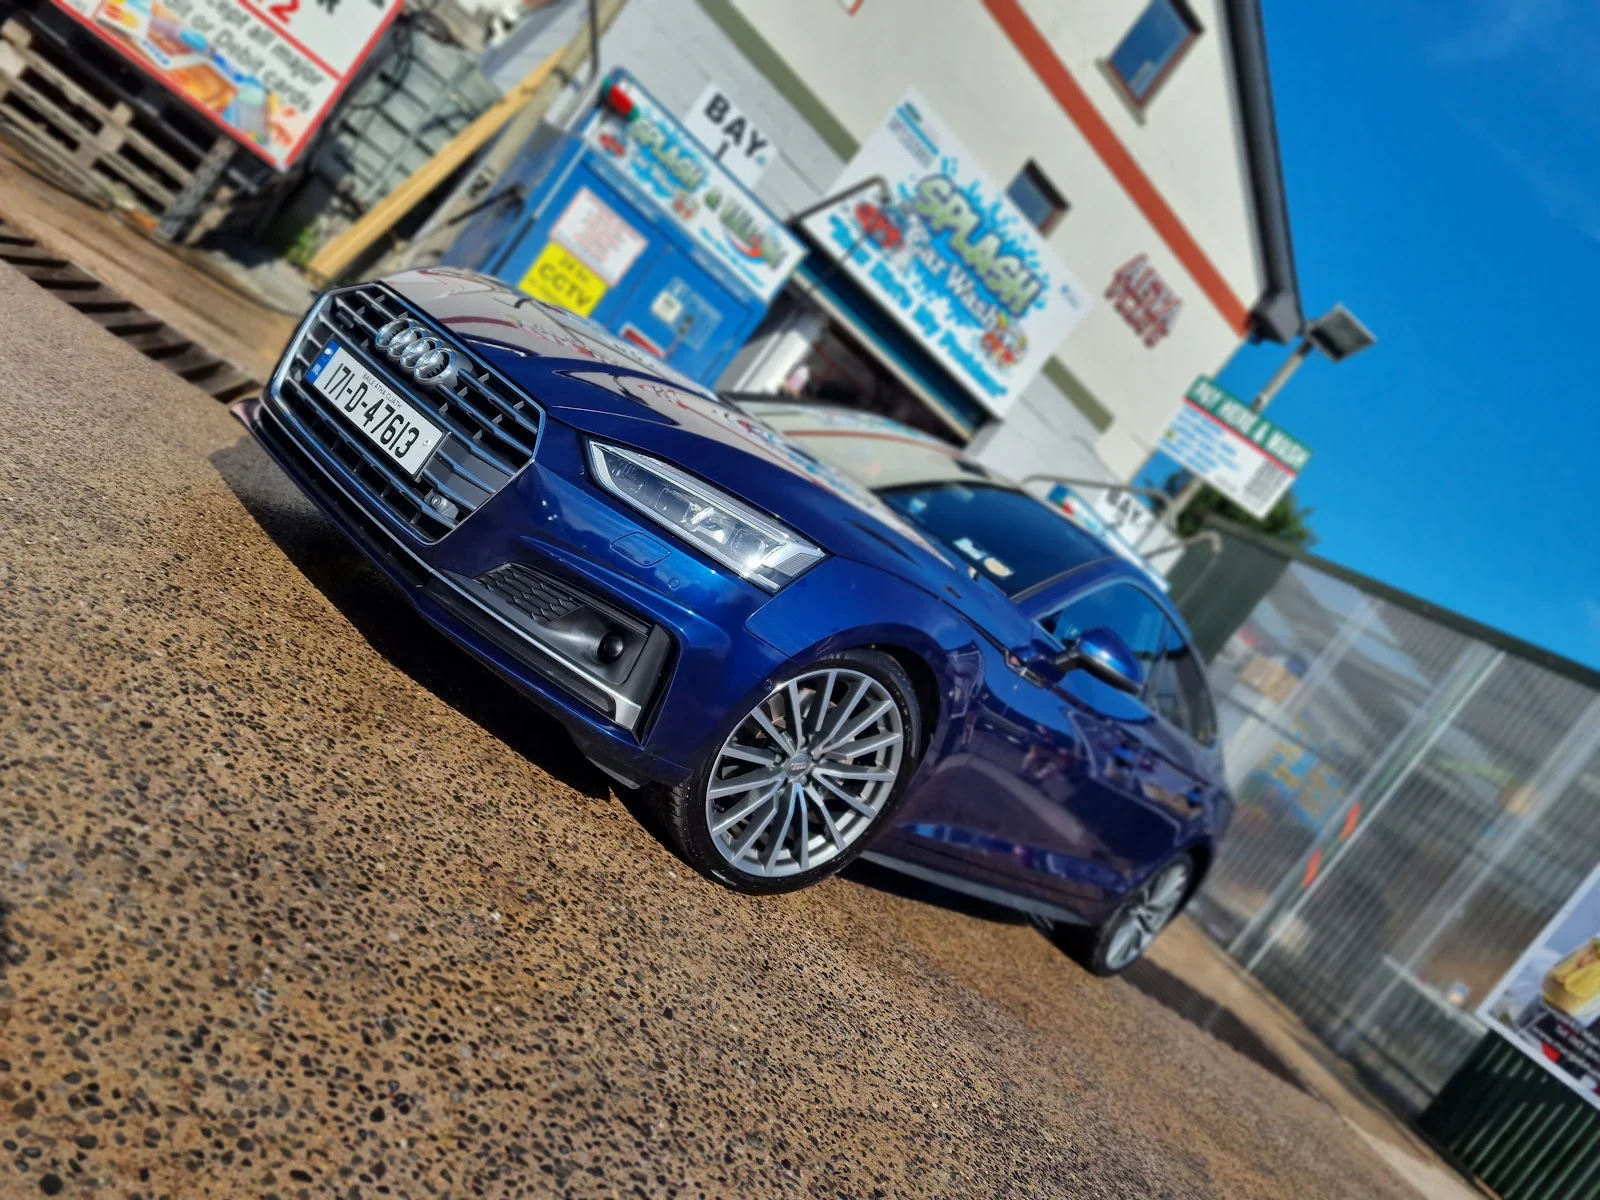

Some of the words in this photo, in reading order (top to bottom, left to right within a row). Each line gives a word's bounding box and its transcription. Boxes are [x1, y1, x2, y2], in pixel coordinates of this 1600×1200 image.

[270, 43, 324, 87] major
[704, 92, 767, 158] BAY
[915, 173, 1045, 318] SPLASH
[537, 262, 595, 309] CCTV
[944, 263, 1001, 330] Wash
[323, 362, 420, 459] 171-D-47613
[362, 372, 375, 387] BAILE
[385, 393, 403, 410] CLIATH
